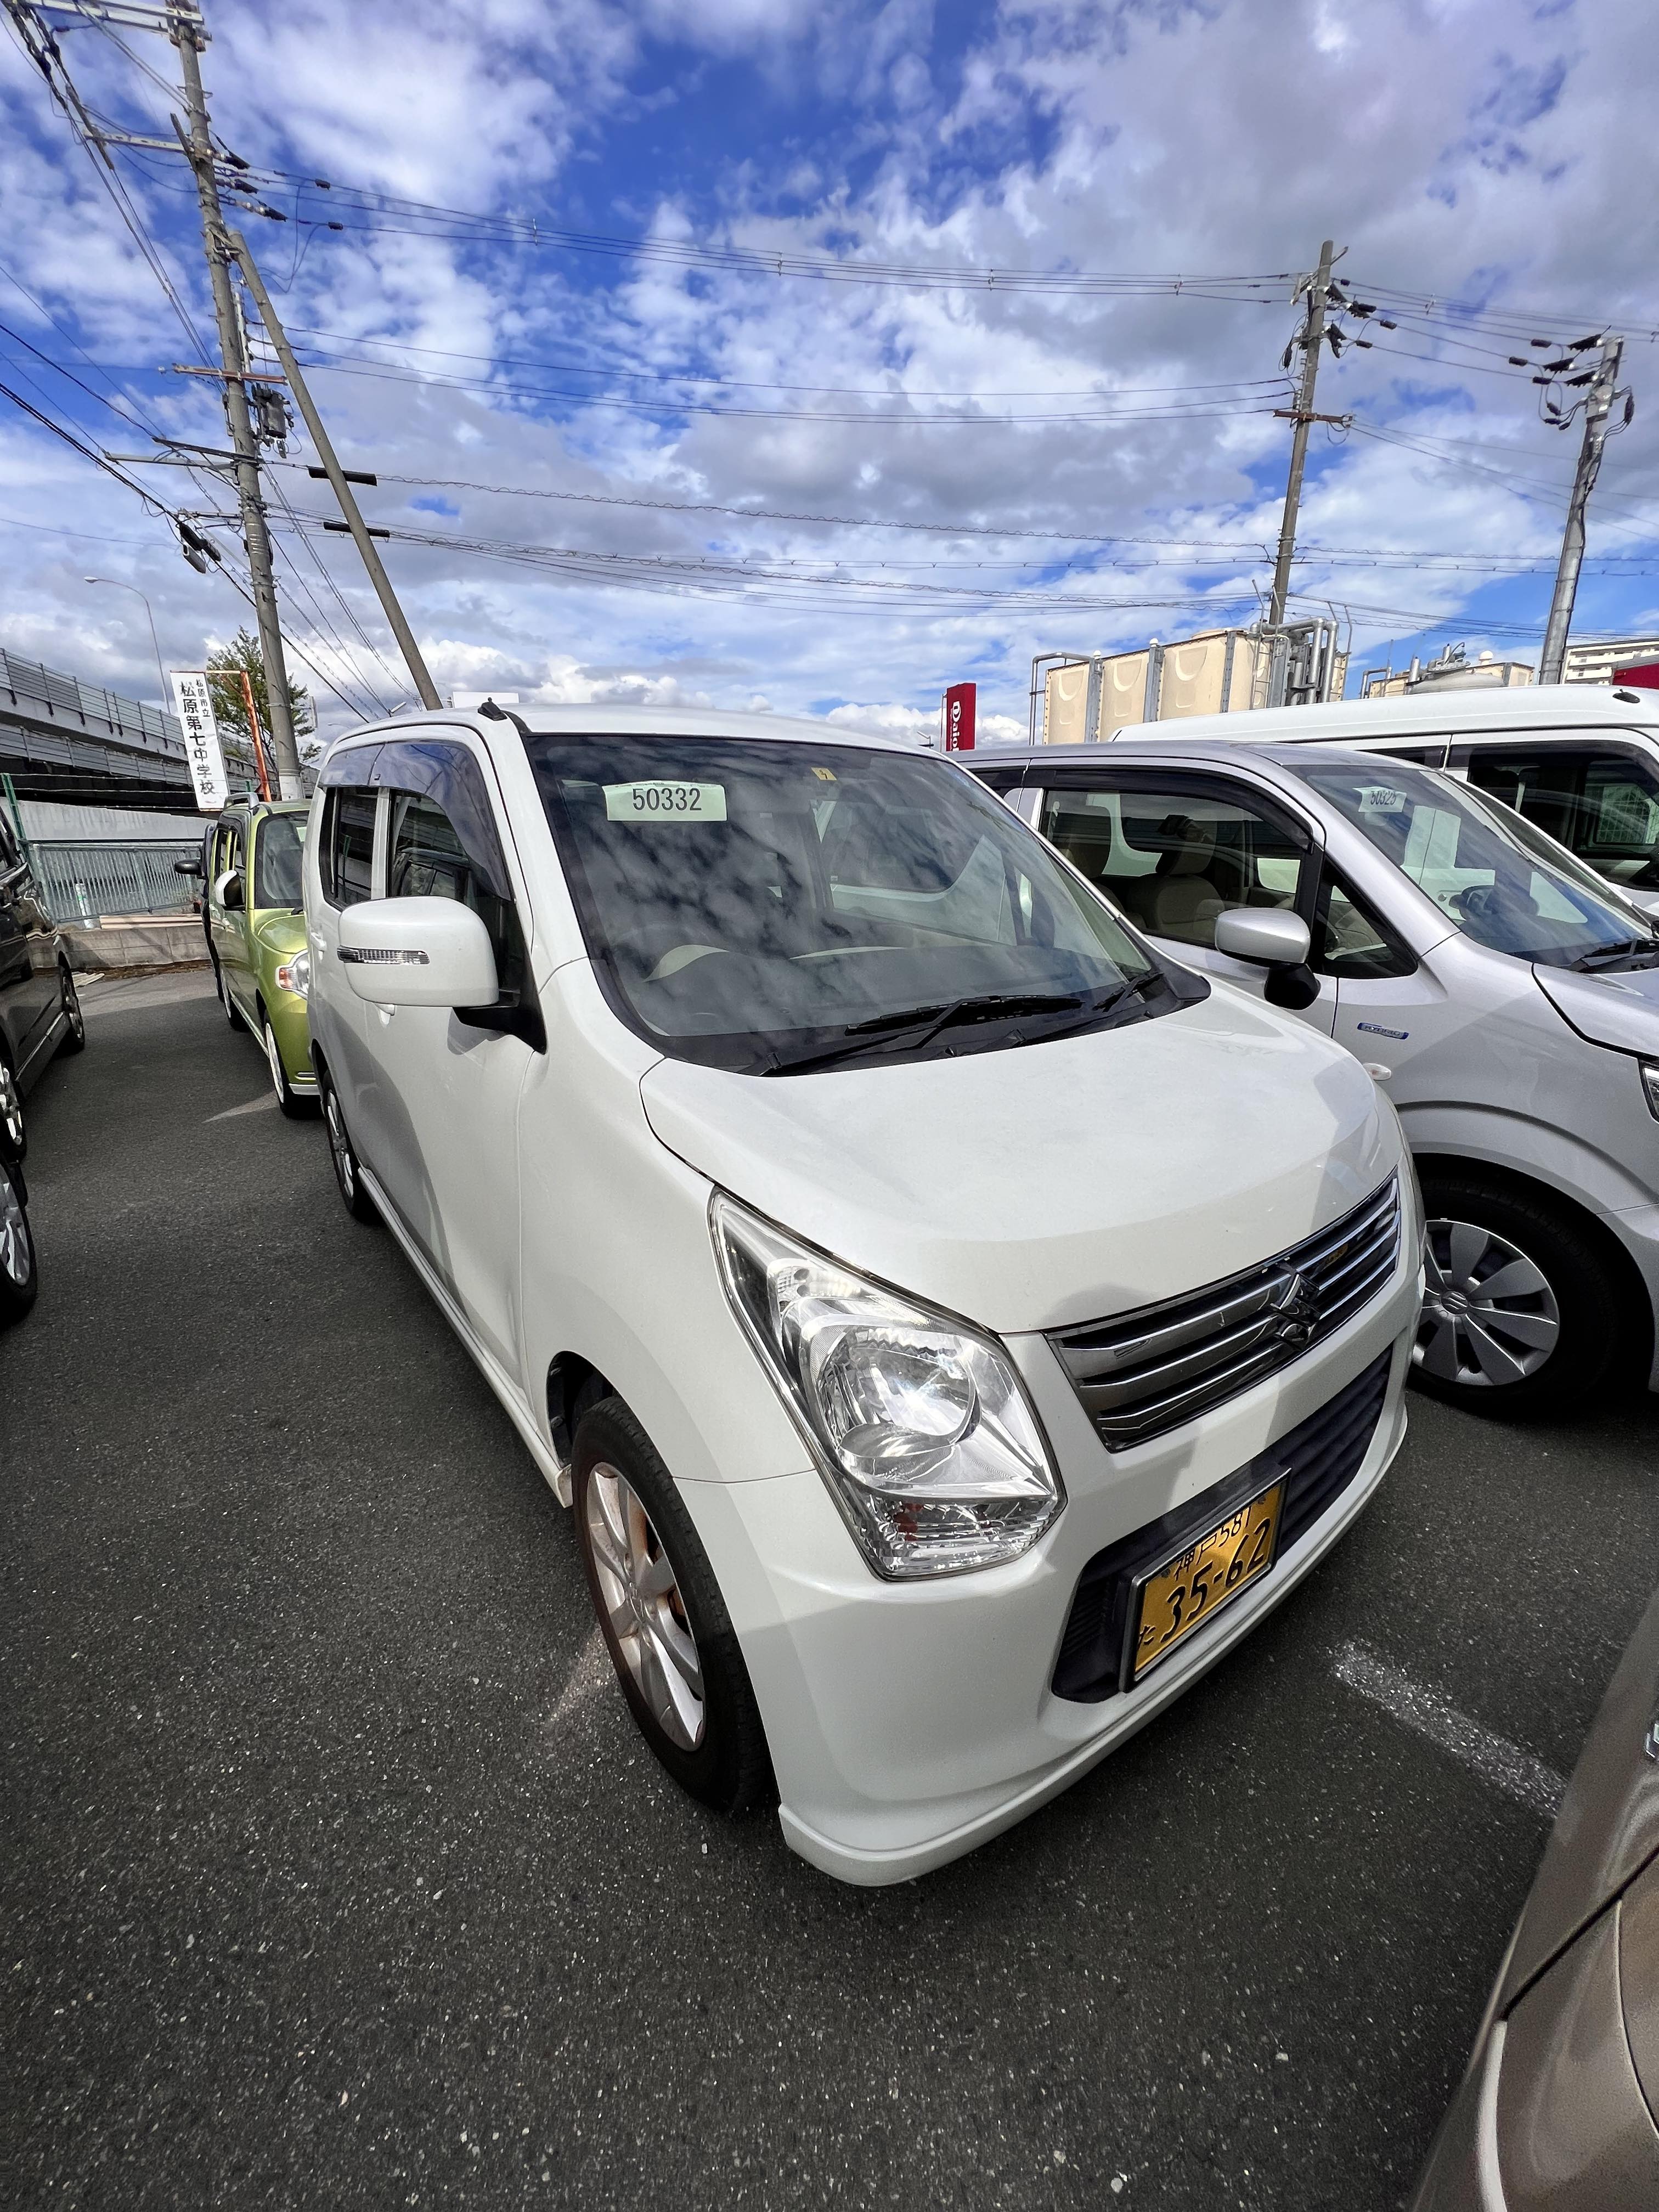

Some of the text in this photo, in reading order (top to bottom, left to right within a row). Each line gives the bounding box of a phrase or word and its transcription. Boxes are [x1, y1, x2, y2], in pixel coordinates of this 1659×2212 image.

[196, 679, 211, 718] 松原市立
[180, 681, 216, 795] 松原第七中学校
[633, 788, 702, 811] 50332
[1160, 1518, 1271, 1644] 35-62
